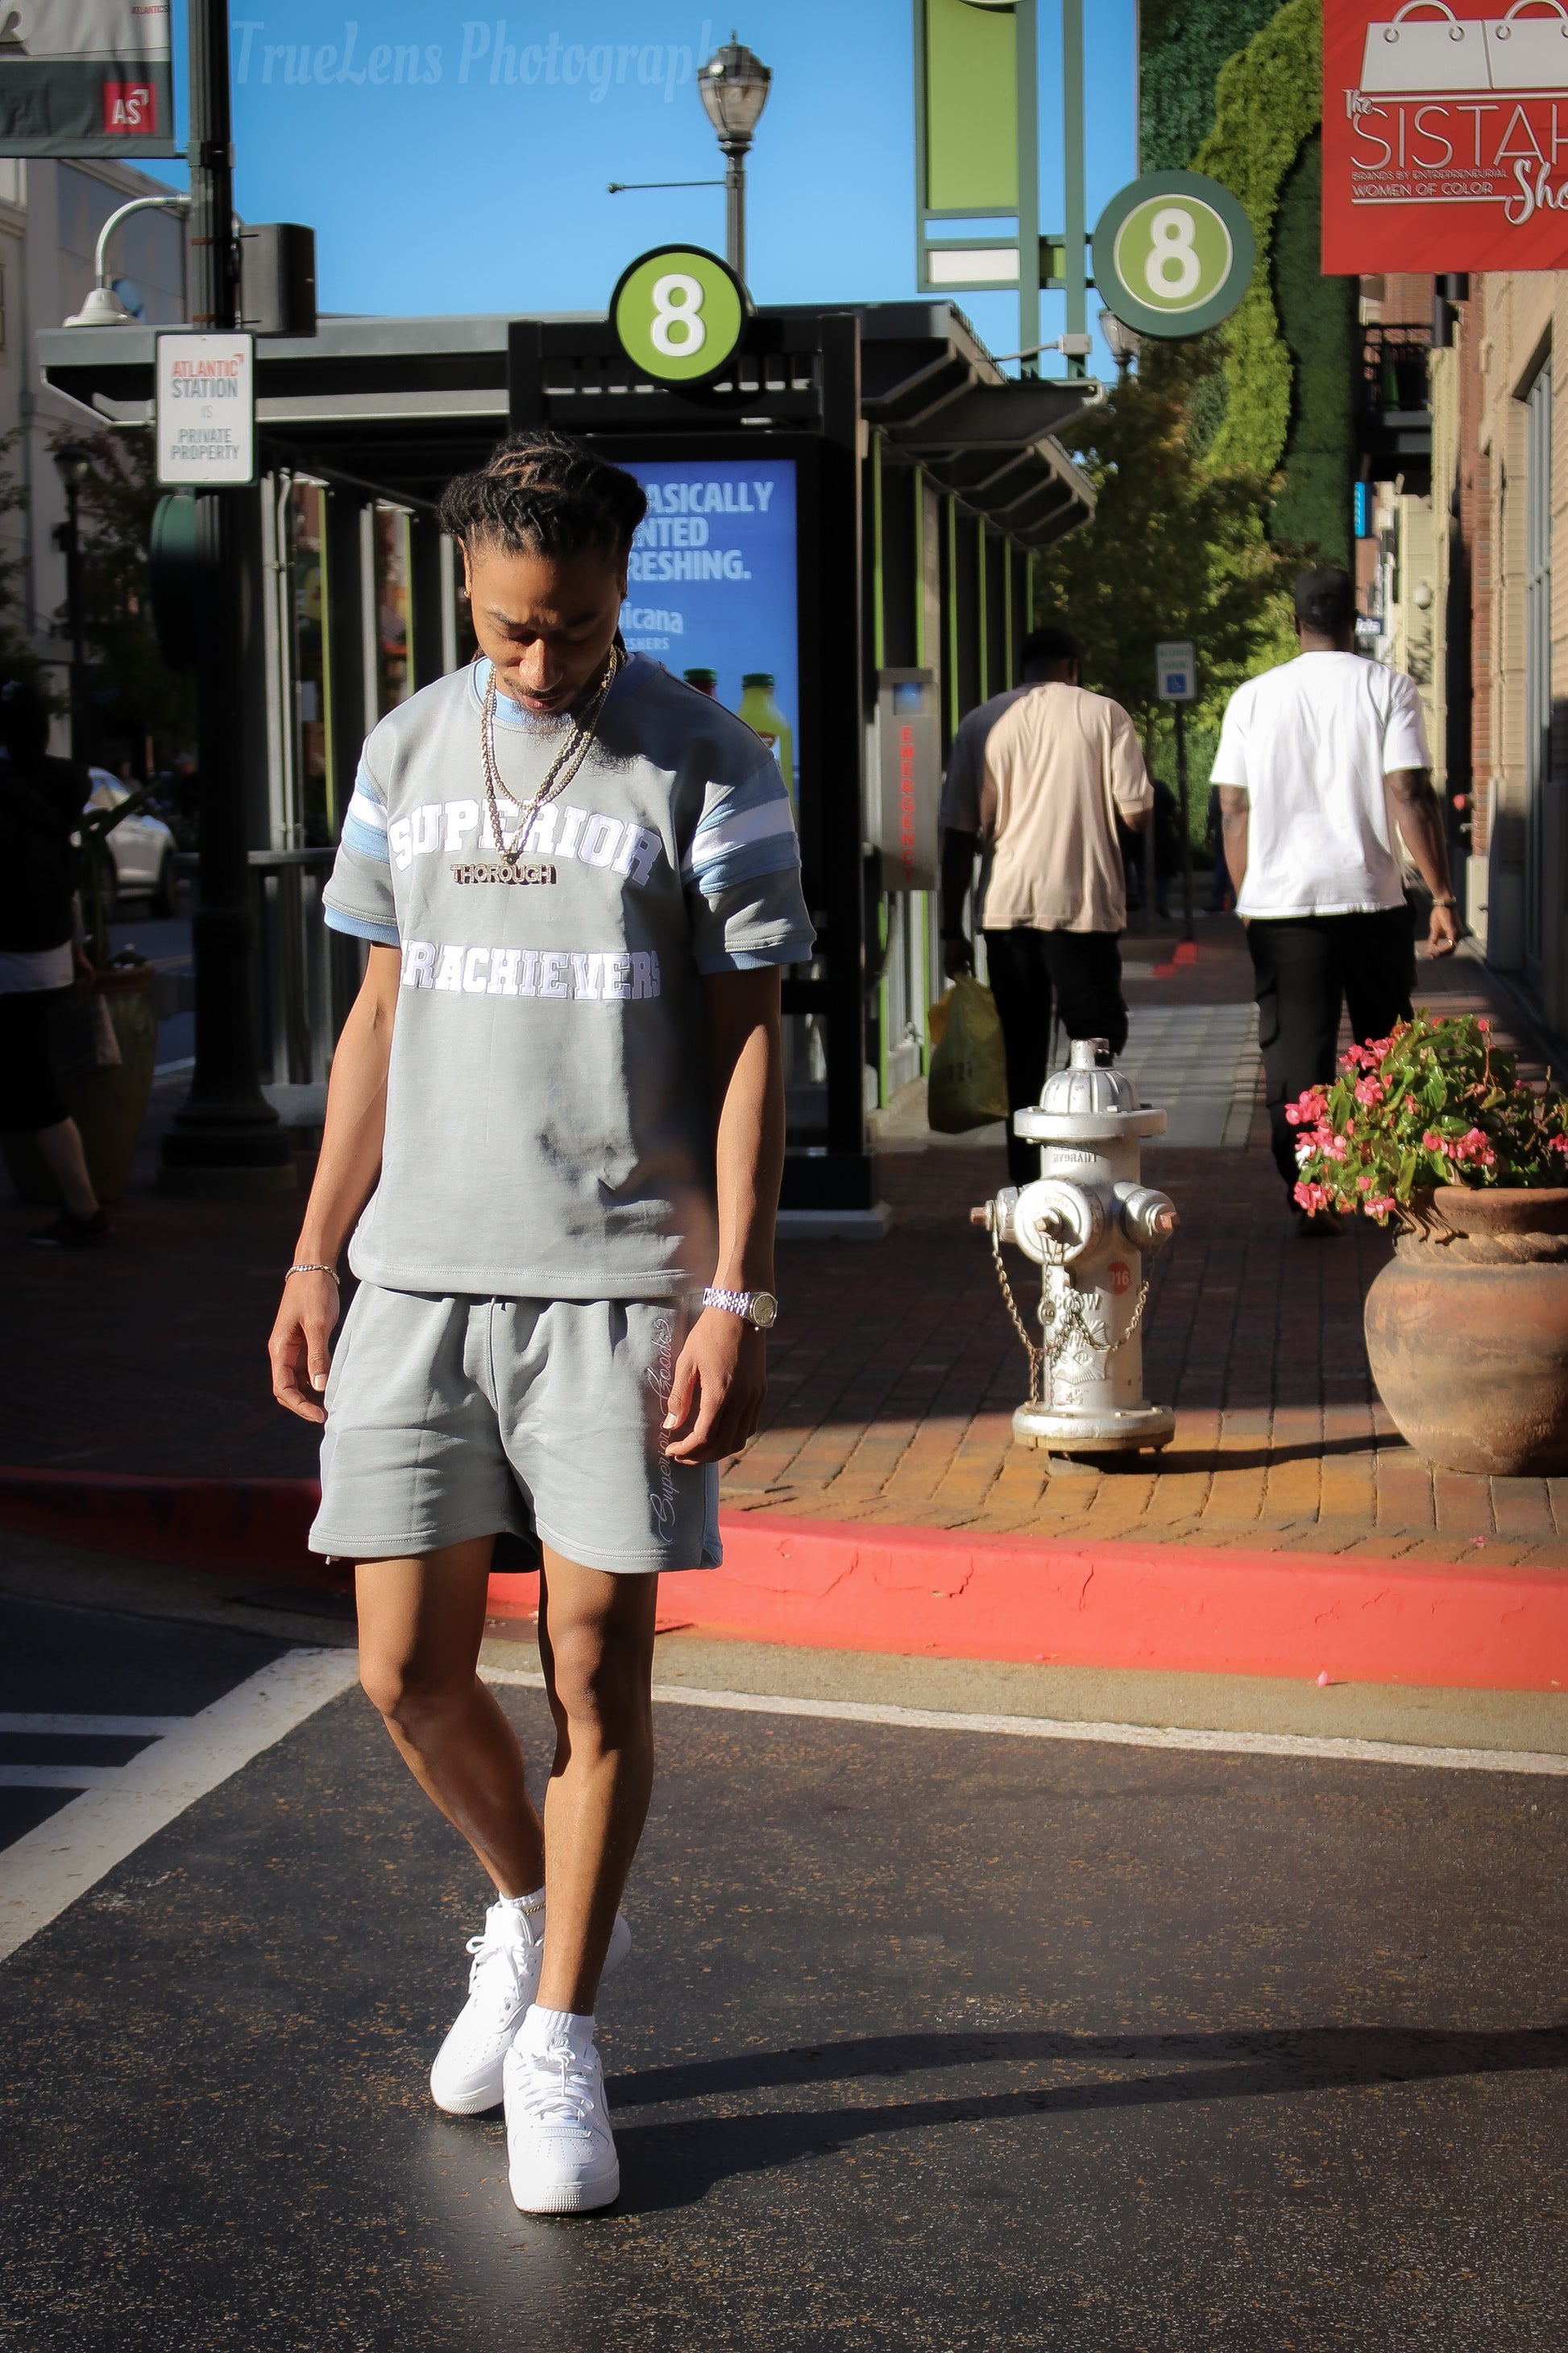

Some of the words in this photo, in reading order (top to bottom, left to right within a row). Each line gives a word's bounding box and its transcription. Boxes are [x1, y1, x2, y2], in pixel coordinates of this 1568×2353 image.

[112, 98, 142, 125] AS
[1342, 89, 1373, 119] The
[1351, 170, 1394, 181] BRANDS
[1352, 184, 1412, 197] WOMEN
[1416, 183, 1437, 196] OF
[1441, 182, 1493, 196] COLOR
[1144, 207, 1201, 299] 8
[651, 272, 706, 357] 8
[172, 360, 239, 377] ATLANTIC
[171, 378, 238, 398] STATION
[201, 405, 214, 418] IS
[179, 428, 232, 443] PRIVATE
[171, 444, 240, 460] PROPERTY
[899, 725, 915, 882] EMERGENCY
[388, 798, 663, 886] SUPERIOR
[450, 862, 558, 886] THOROUGH
[402, 938, 661, 1001] RACHIEVERS
